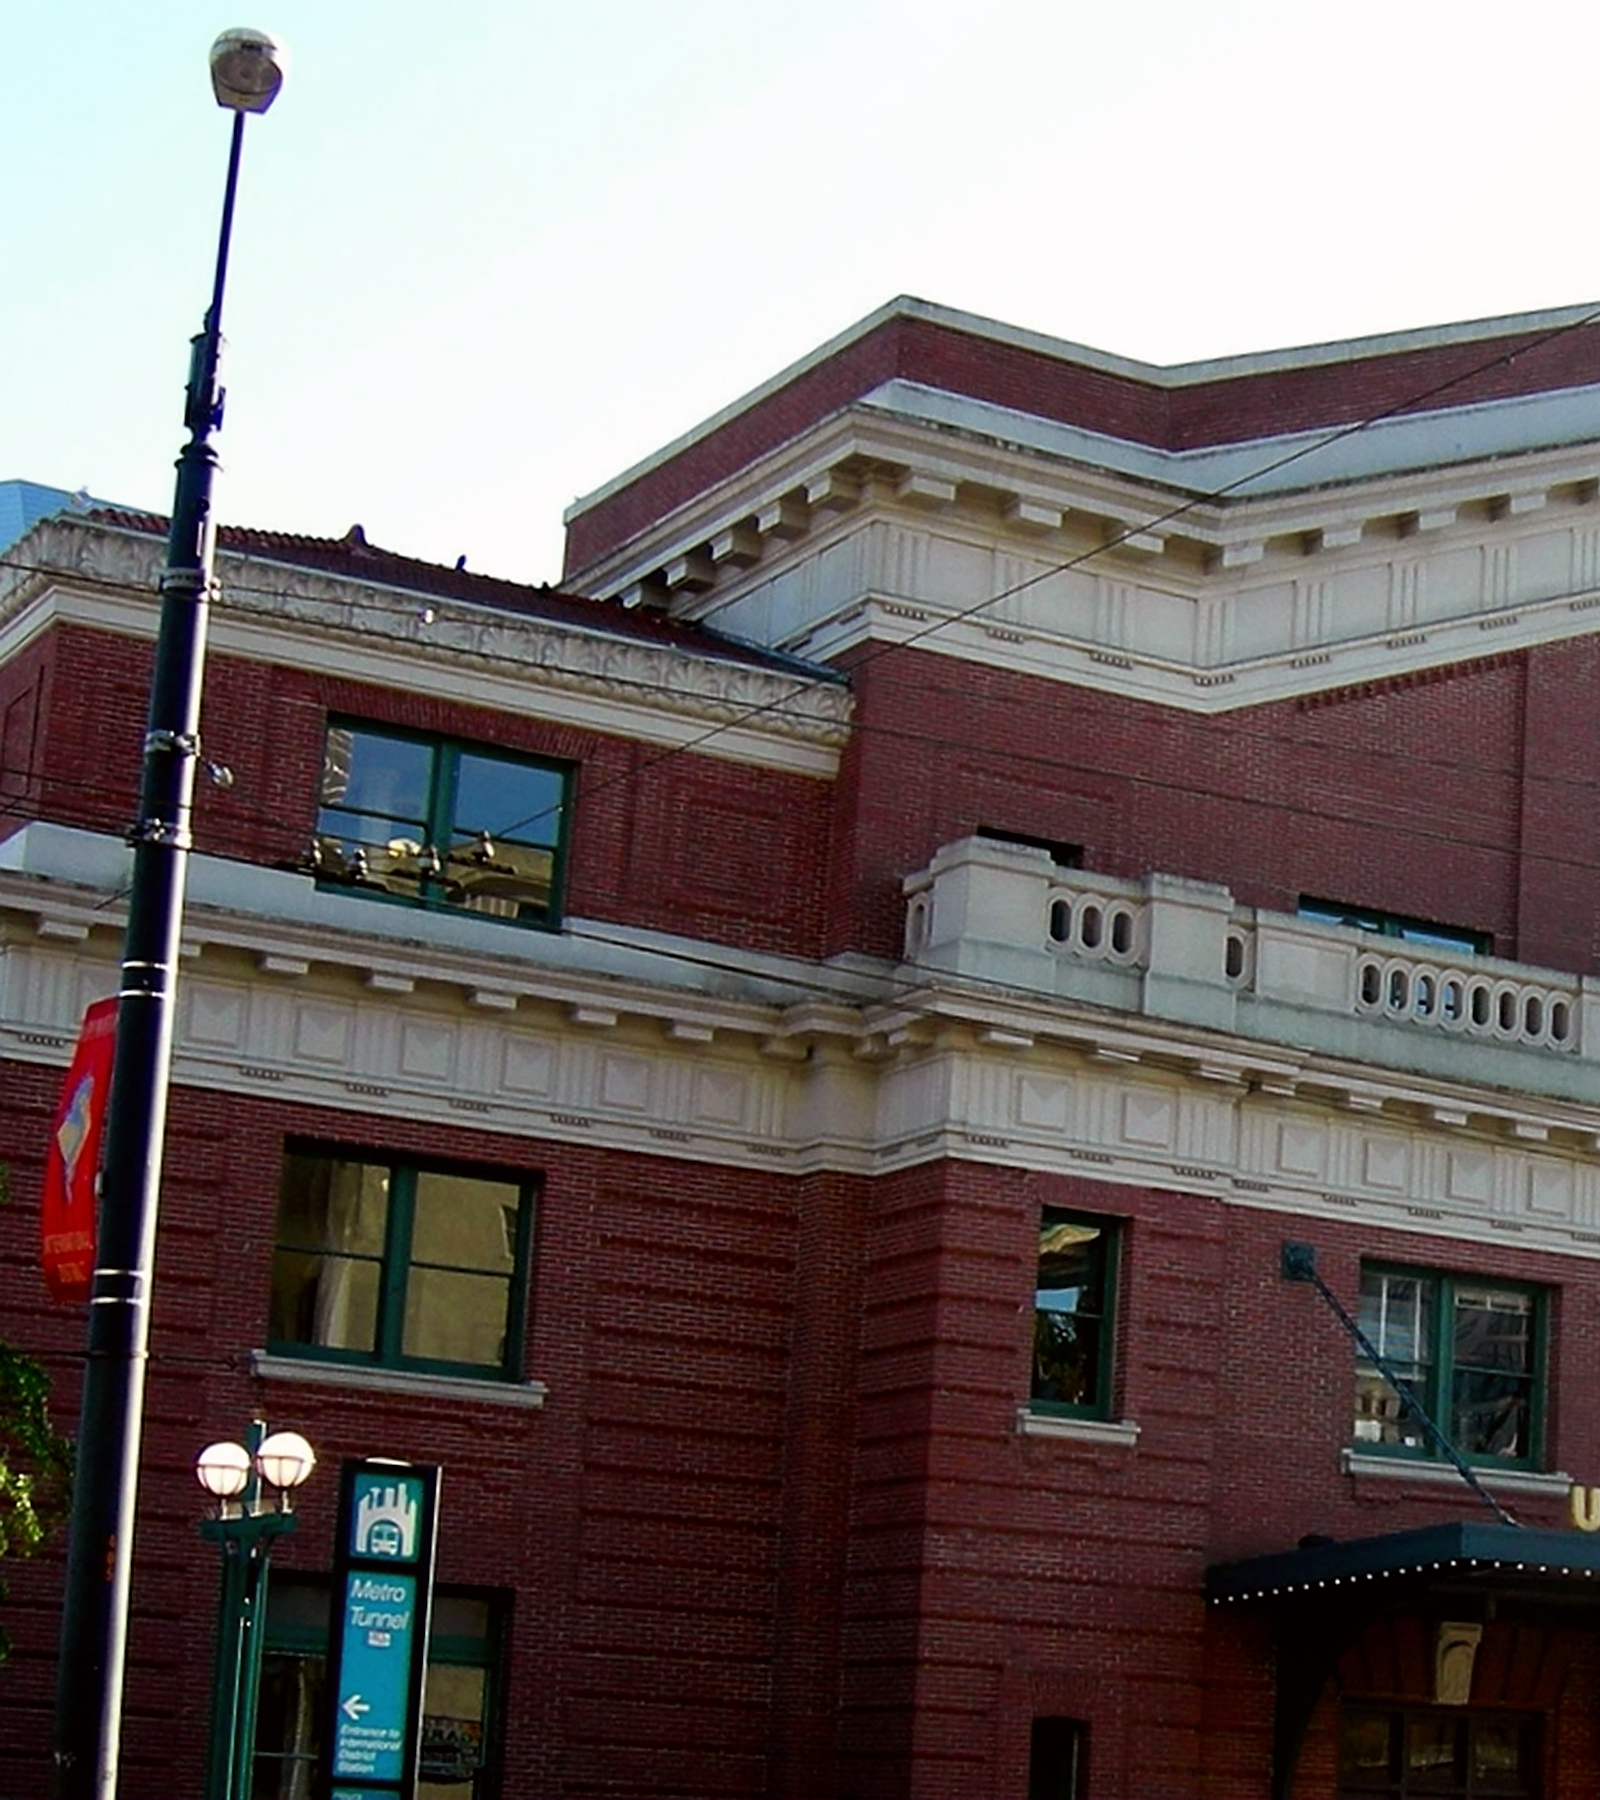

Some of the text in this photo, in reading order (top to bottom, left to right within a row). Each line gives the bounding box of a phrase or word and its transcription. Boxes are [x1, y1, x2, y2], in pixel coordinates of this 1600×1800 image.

[351, 1579, 406, 1602] Metro
[351, 1605, 409, 1630] Tunnel
[340, 1724, 387, 1738] Entrance
[340, 1738, 402, 1751] International
[338, 1748, 376, 1761] District
[337, 1761, 374, 1773] Station
